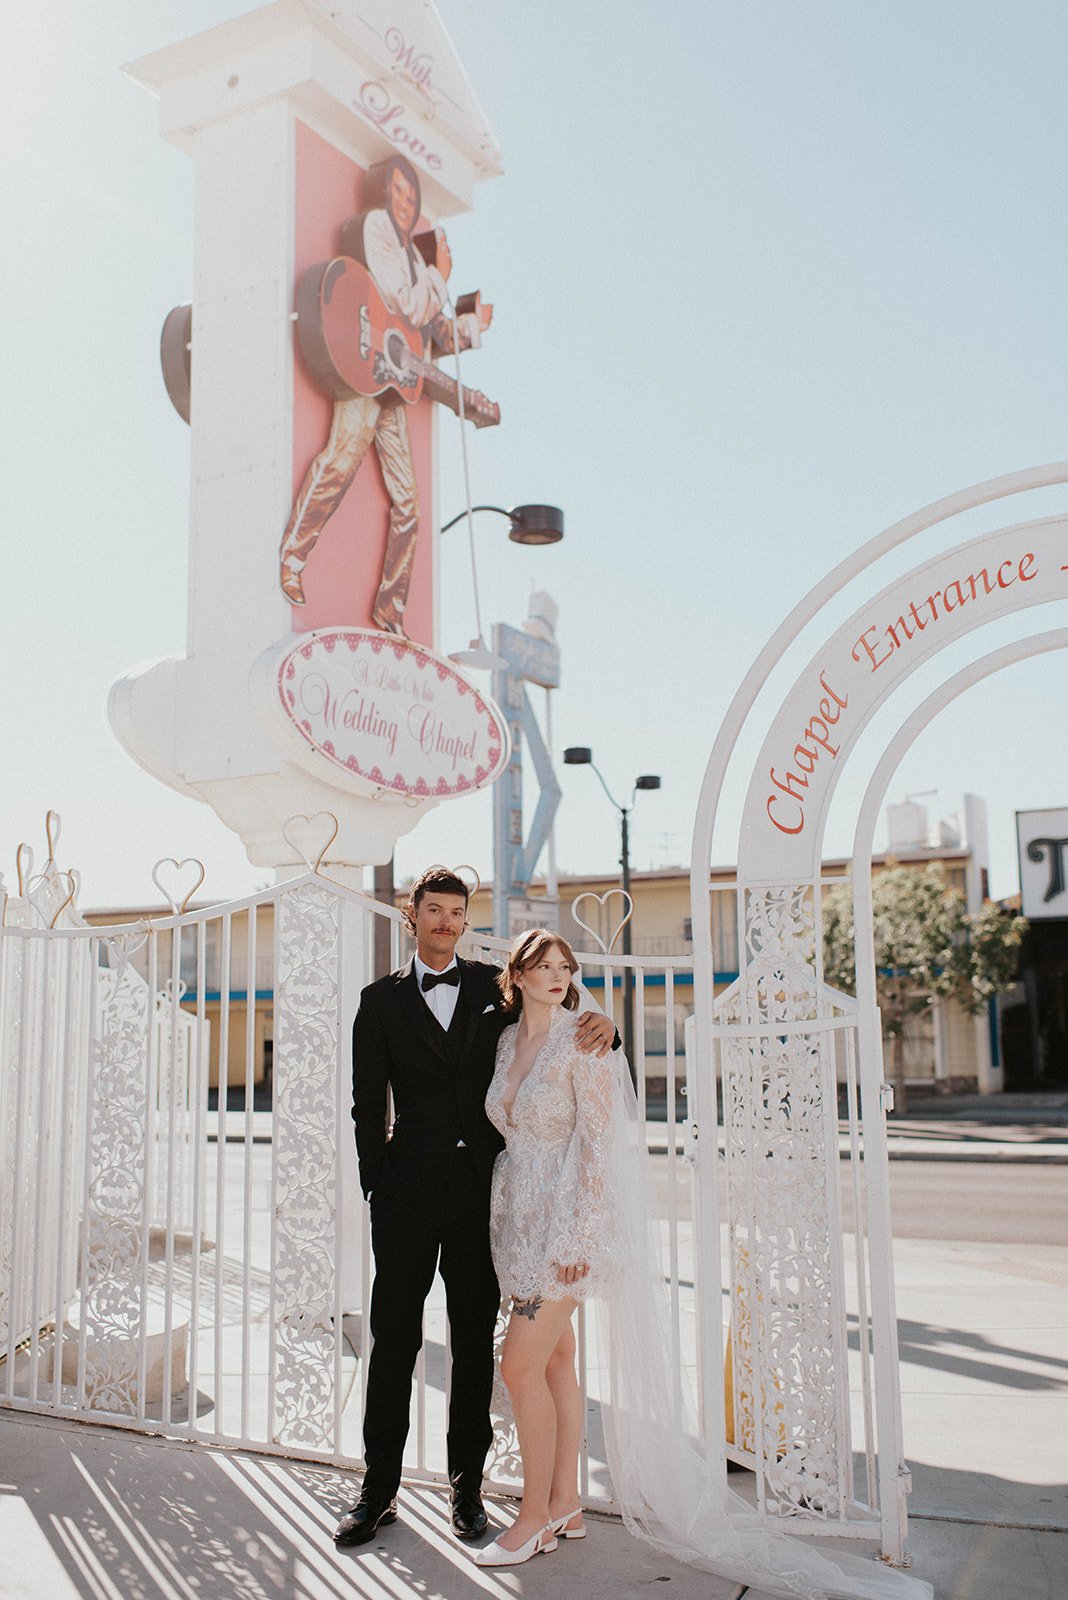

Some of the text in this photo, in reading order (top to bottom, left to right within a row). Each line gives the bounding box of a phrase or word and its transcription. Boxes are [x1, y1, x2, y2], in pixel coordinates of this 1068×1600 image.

[353, 80, 442, 170] Love
[299, 672, 399, 756] Wedding
[406, 704, 477, 771] Chapel
[766, 552, 1040, 835] Chapel Entrance
